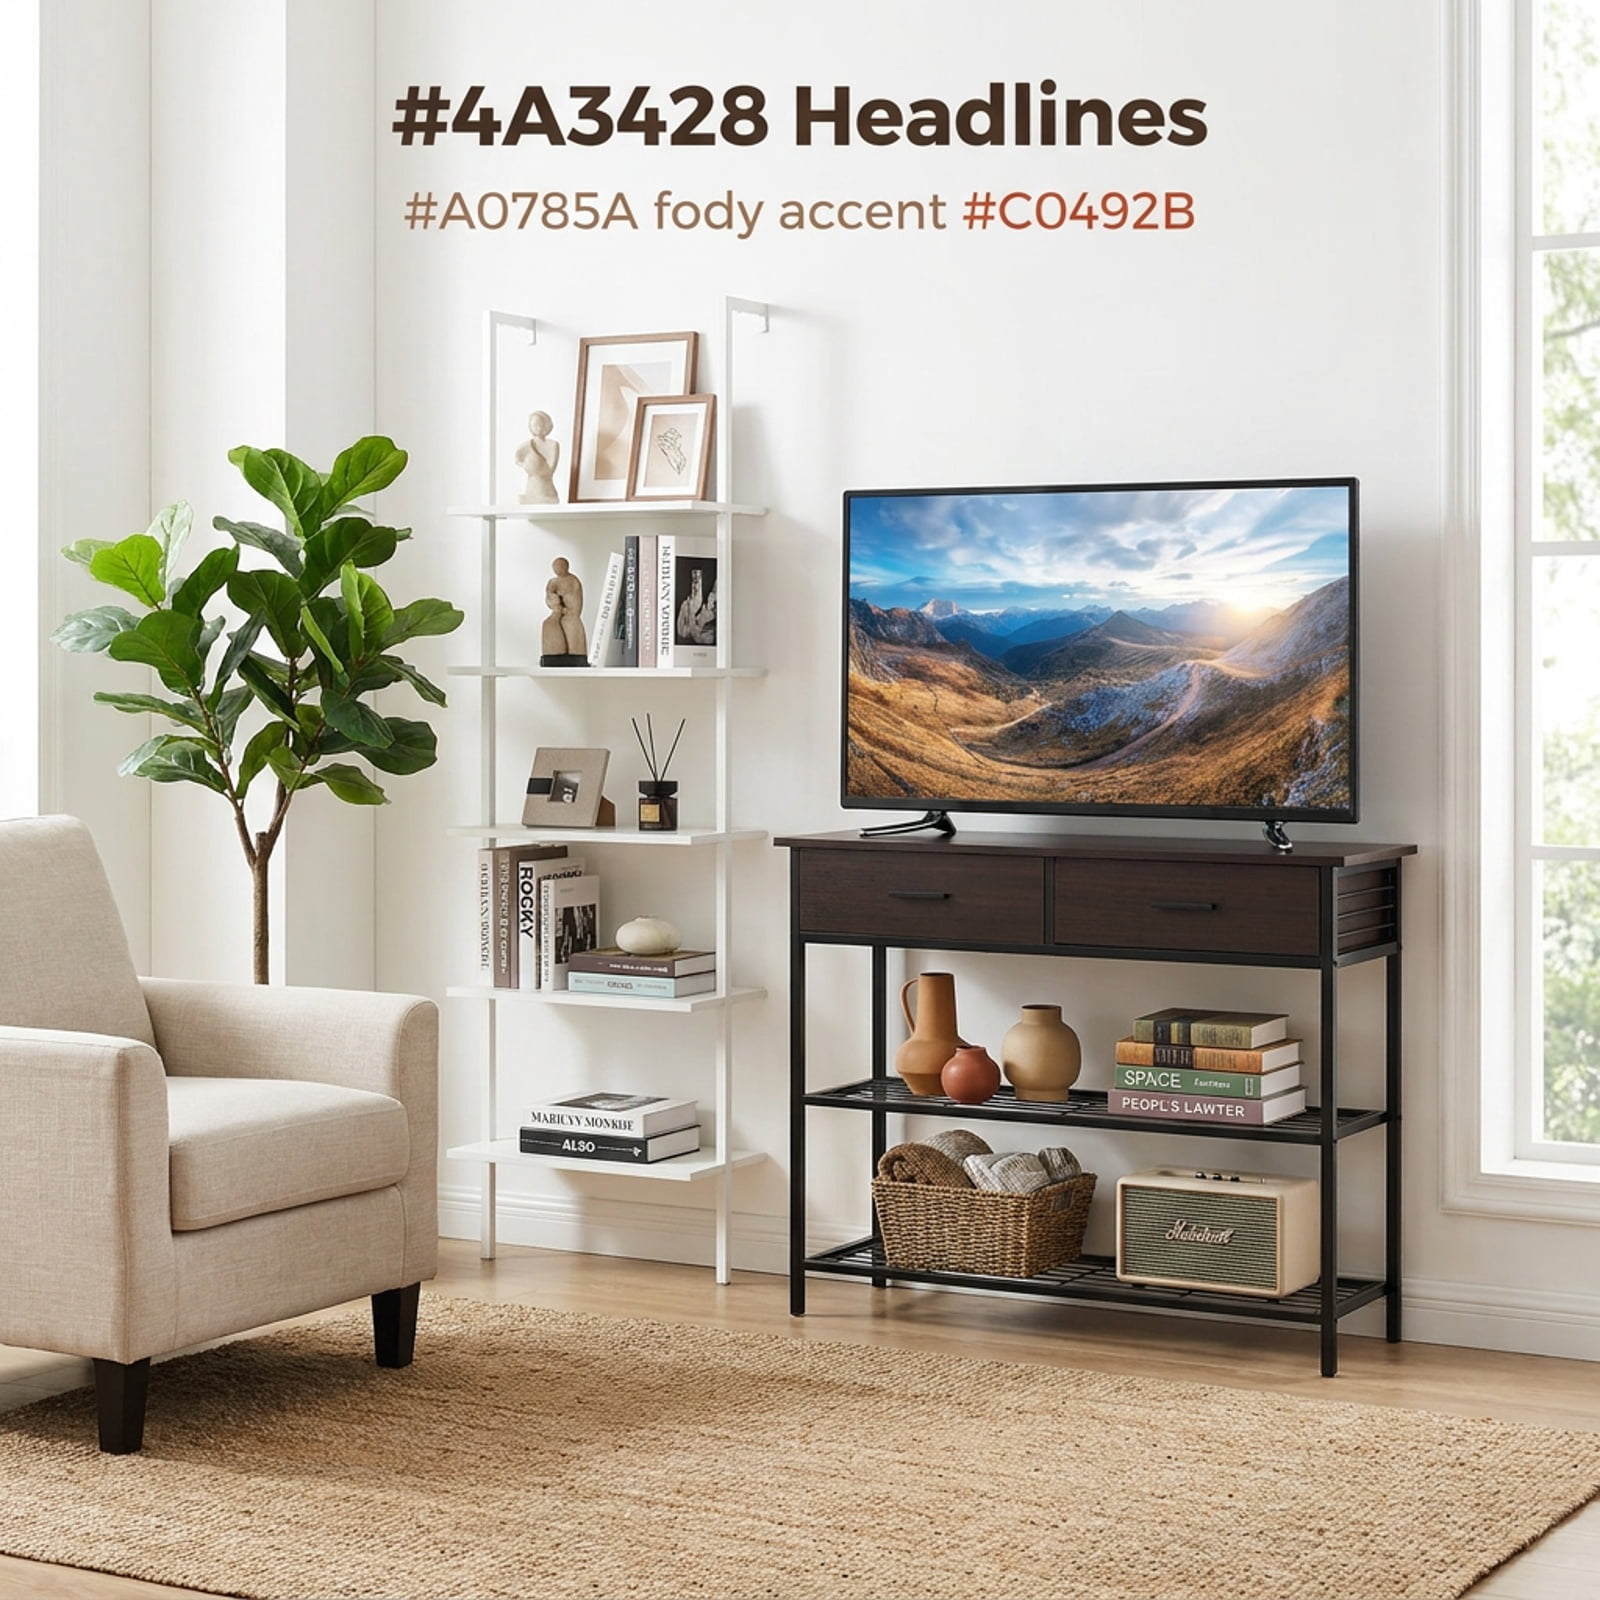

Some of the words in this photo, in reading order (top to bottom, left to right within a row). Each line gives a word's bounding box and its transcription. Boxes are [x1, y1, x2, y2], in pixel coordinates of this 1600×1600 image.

[1124, 1070, 1182, 1089] SPACE
[1184, 1102, 1245, 1117] LAWTER
[562, 1138, 595, 1153] ALSO
